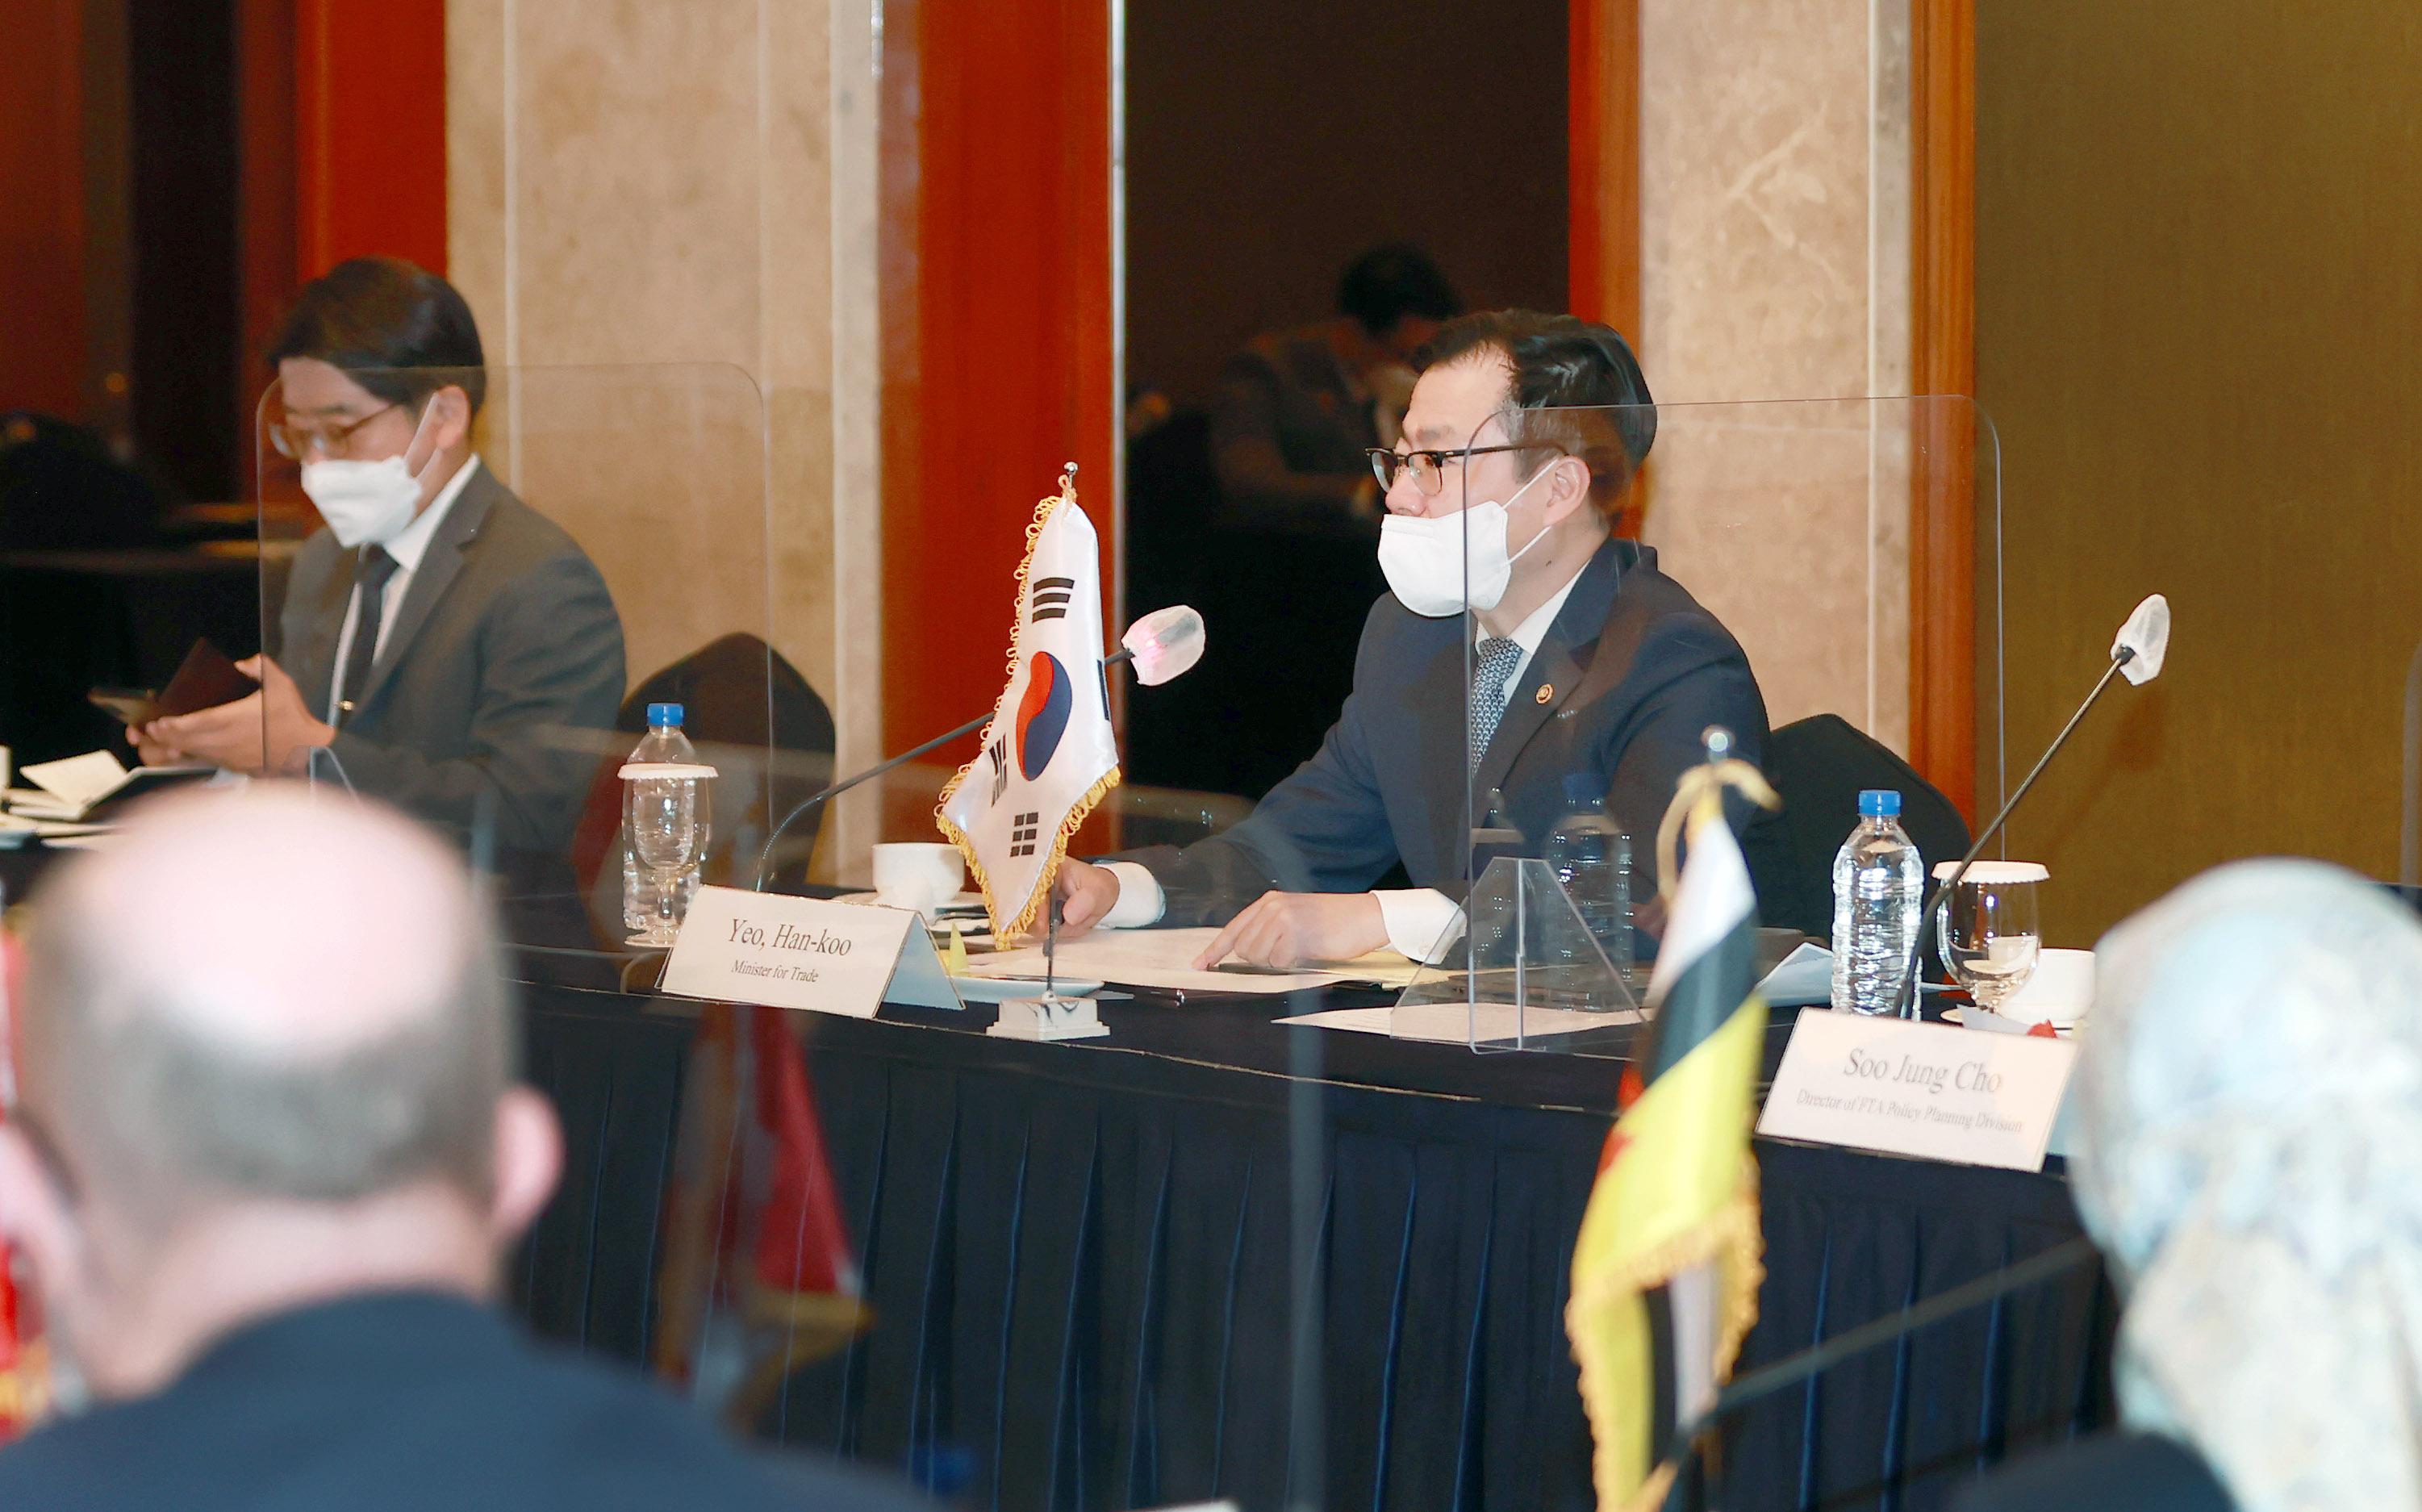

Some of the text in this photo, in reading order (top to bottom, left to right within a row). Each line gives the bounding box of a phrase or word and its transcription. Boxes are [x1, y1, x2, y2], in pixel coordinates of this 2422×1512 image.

[728, 918, 851, 956] Yeo, Han-koo
[731, 960, 819, 983] Minister for Trade
[1843, 1048, 2002, 1093] Soo Jung Cho
[1796, 1088, 2023, 1133] Director of FTA Policy Planning Division
